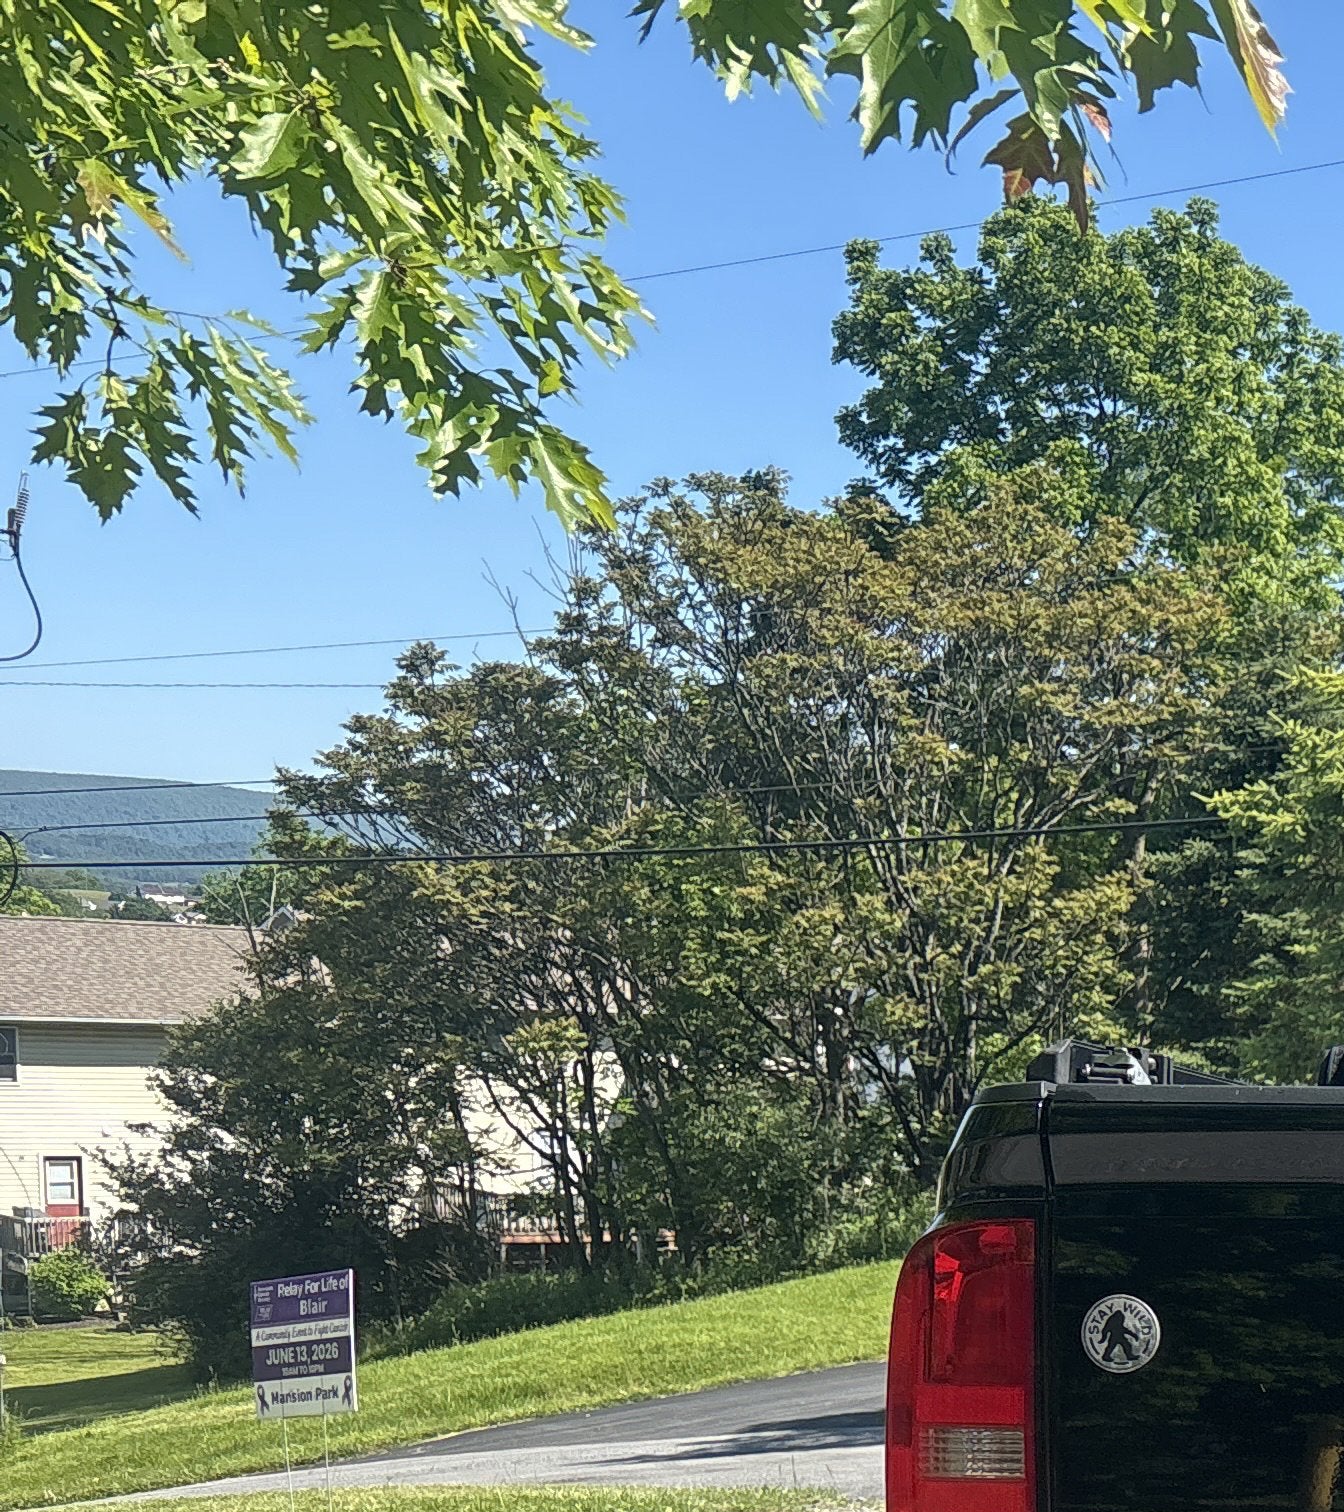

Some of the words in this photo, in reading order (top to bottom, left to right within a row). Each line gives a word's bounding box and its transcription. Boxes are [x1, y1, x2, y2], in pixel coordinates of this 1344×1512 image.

[277, 1281, 303, 1299] Relay
[304, 1279, 320, 1294] For
[321, 1275, 338, 1292] Life
[339, 1274, 349, 1290] of
[299, 1297, 328, 1316] Blair
[1088, 1302, 1114, 1335] STAY
[1123, 1301, 1153, 1336] WILD
[265, 1346, 295, 1366] JUNE
[295, 1345, 311, 1364] 13,
[311, 1342, 339, 1361] 2026
[270, 1388, 313, 1405] Mansion
[315, 1384, 340, 1401] Park
